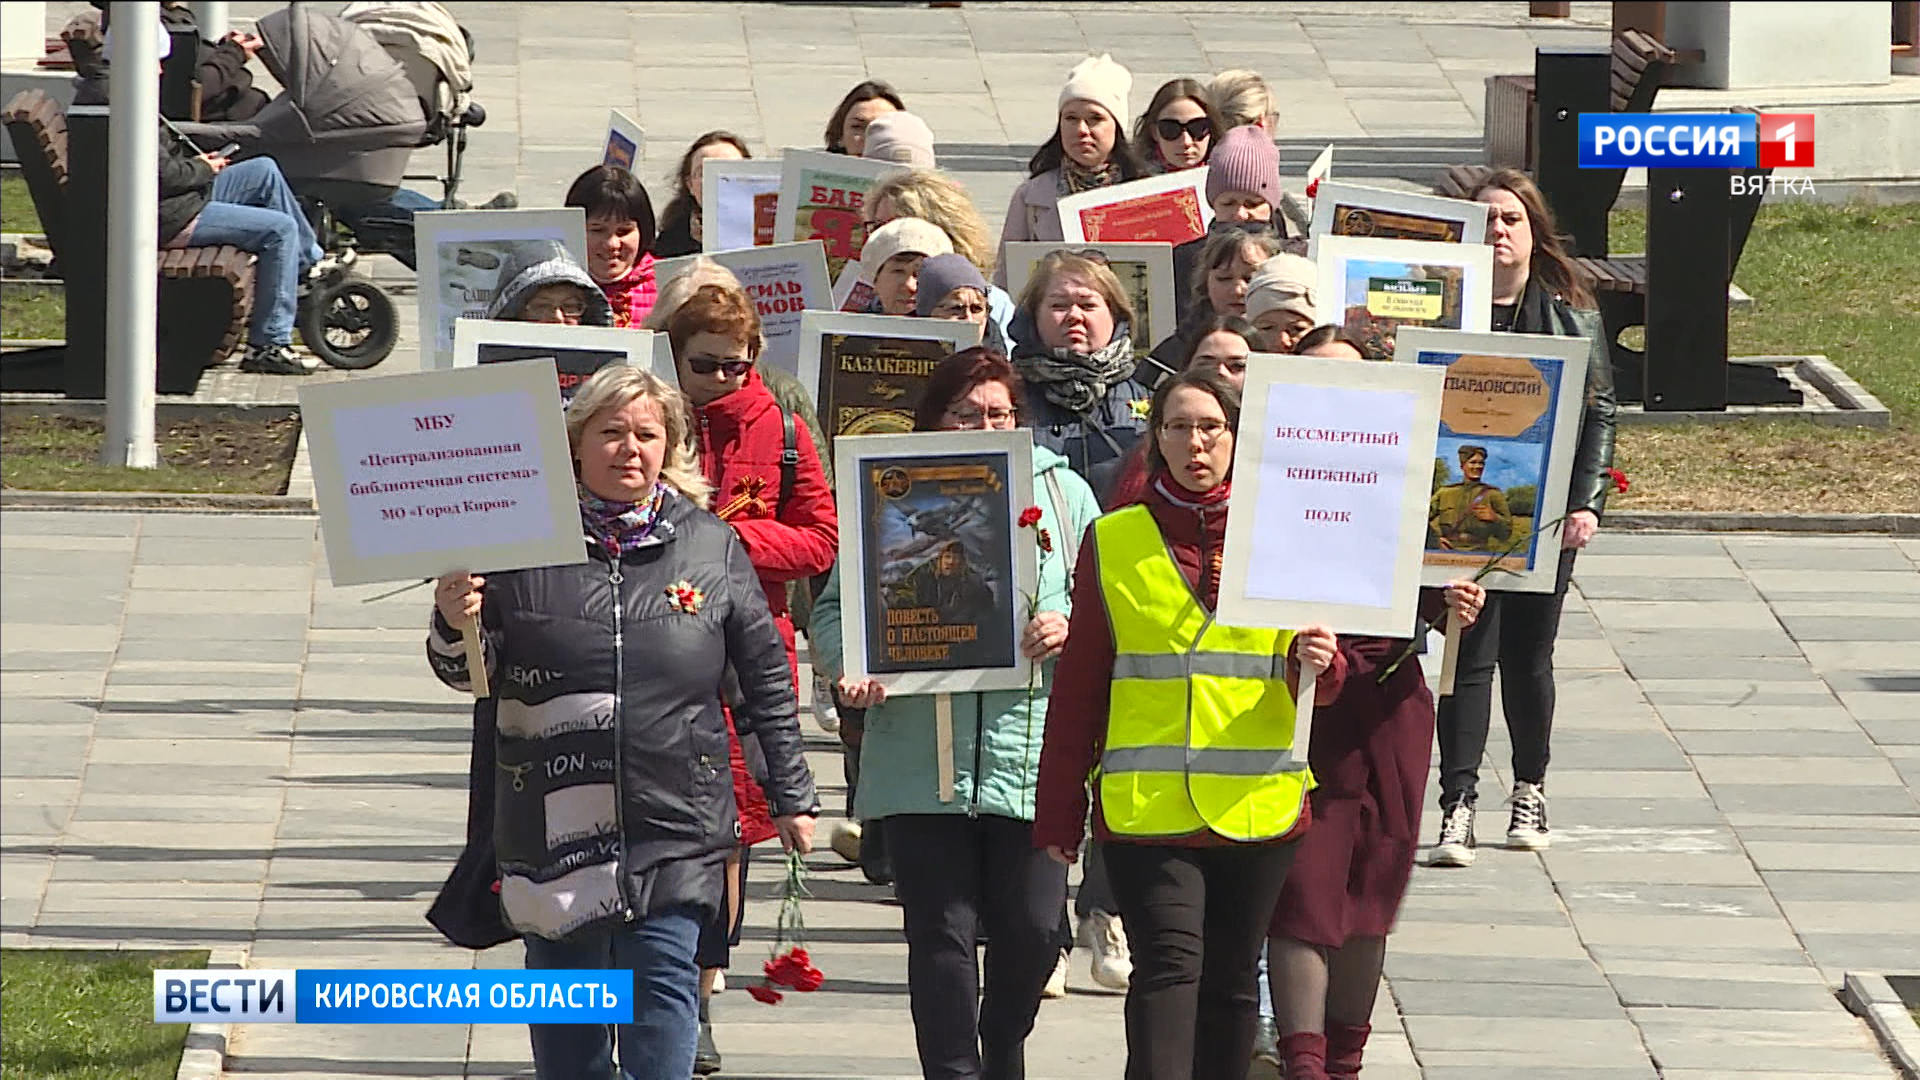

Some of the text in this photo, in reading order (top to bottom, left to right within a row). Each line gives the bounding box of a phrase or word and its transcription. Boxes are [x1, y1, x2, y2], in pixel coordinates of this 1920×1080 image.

[745, 280, 802, 300] СИЛЬ
[757, 297, 806, 317] КОВ
[414, 414, 455, 432] МБУ
[1276, 427, 1399, 446] БЕССМЕРТНЫЙ
[359, 443, 522, 467] «Централизованная
[350, 468, 539, 496] библиотечная система»
[1287, 467, 1378, 484] КНИЖНЫЙ
[380, 499, 517, 521] МО «Город Киров»
[1305, 509, 1351, 522] ПОЛК
[887, 606, 939, 626] ПОВЕСТЬ
[887, 624, 978, 644] О НАСТОЯЩЕМ
